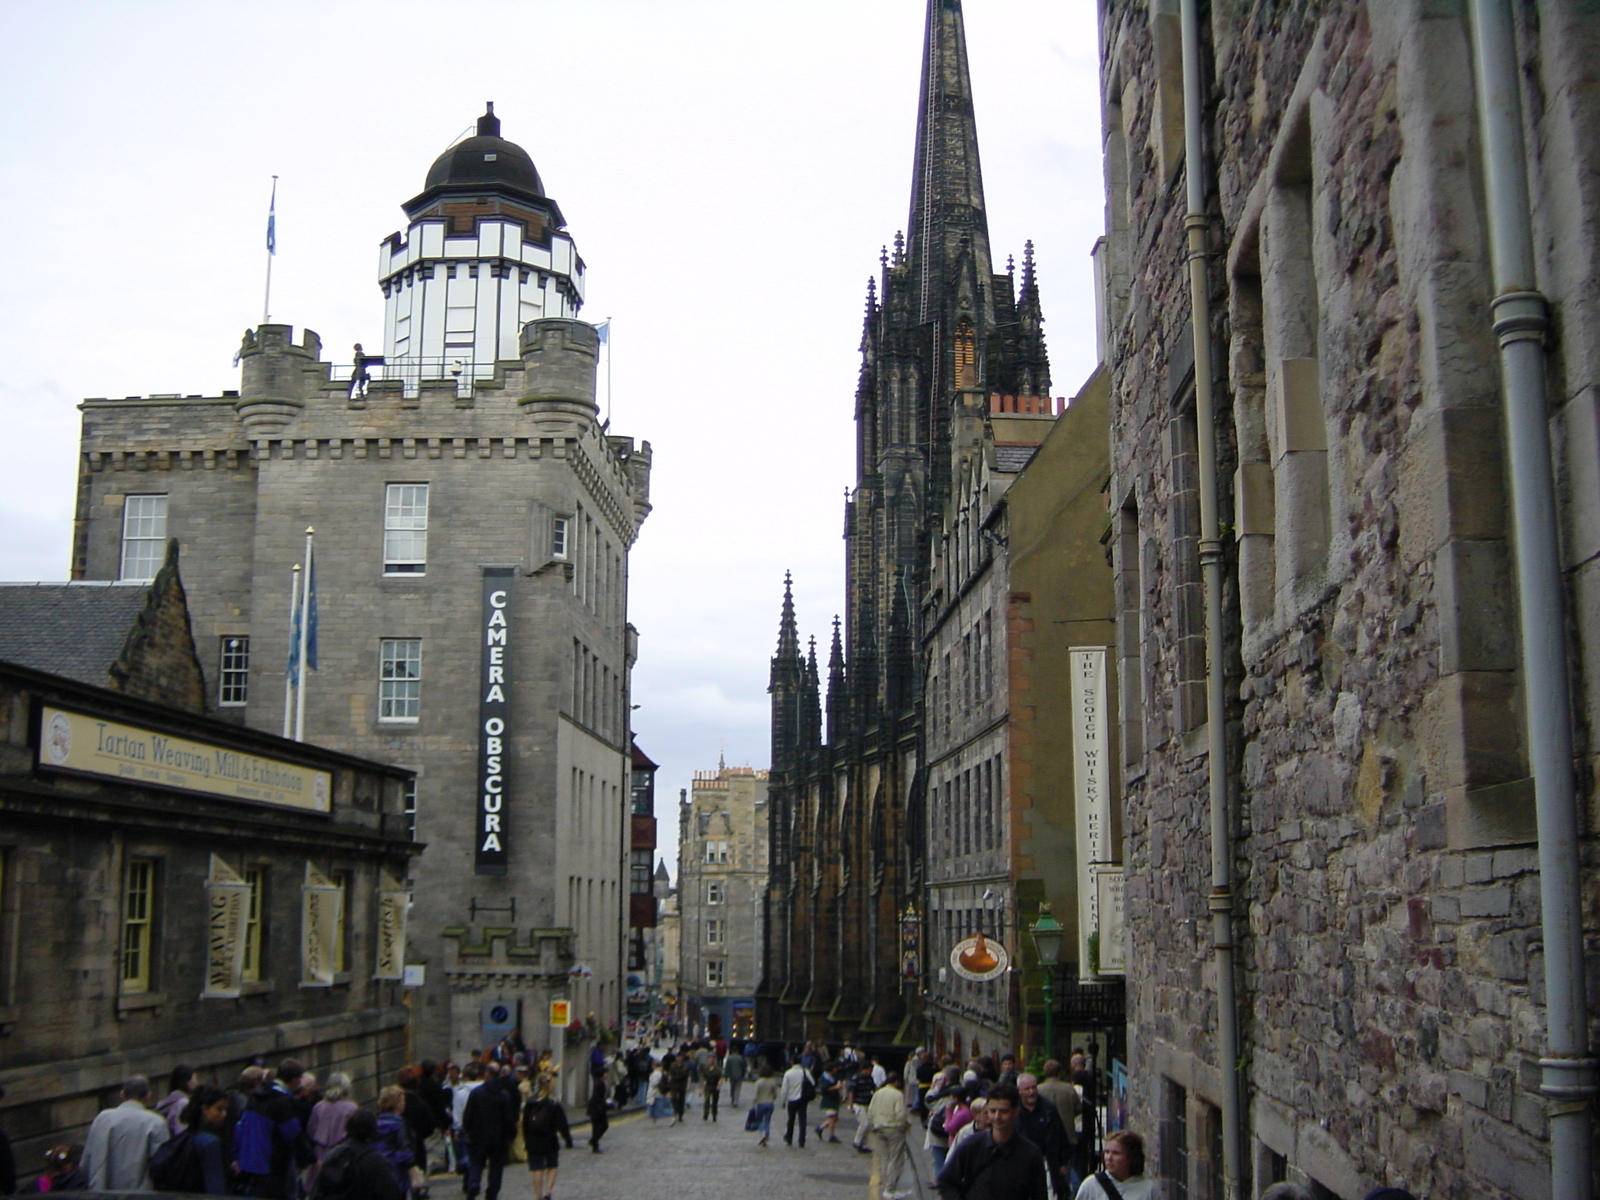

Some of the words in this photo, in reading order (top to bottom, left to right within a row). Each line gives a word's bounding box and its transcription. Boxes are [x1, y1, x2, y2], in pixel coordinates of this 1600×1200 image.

[485, 590, 507, 703] CAMERA
[1082, 653, 1093, 678] THE
[1084, 689, 1096, 740] SCOTCH
[96, 722, 145, 760] Tartan
[151, 735, 210, 779] Weaving
[215, 750, 240, 779] Mill
[252, 758, 303, 791] Exhibition
[482, 717, 505, 852] OBSCURA
[1084, 750, 1099, 803] WHISKY
[210, 895, 226, 986] WEAVING
